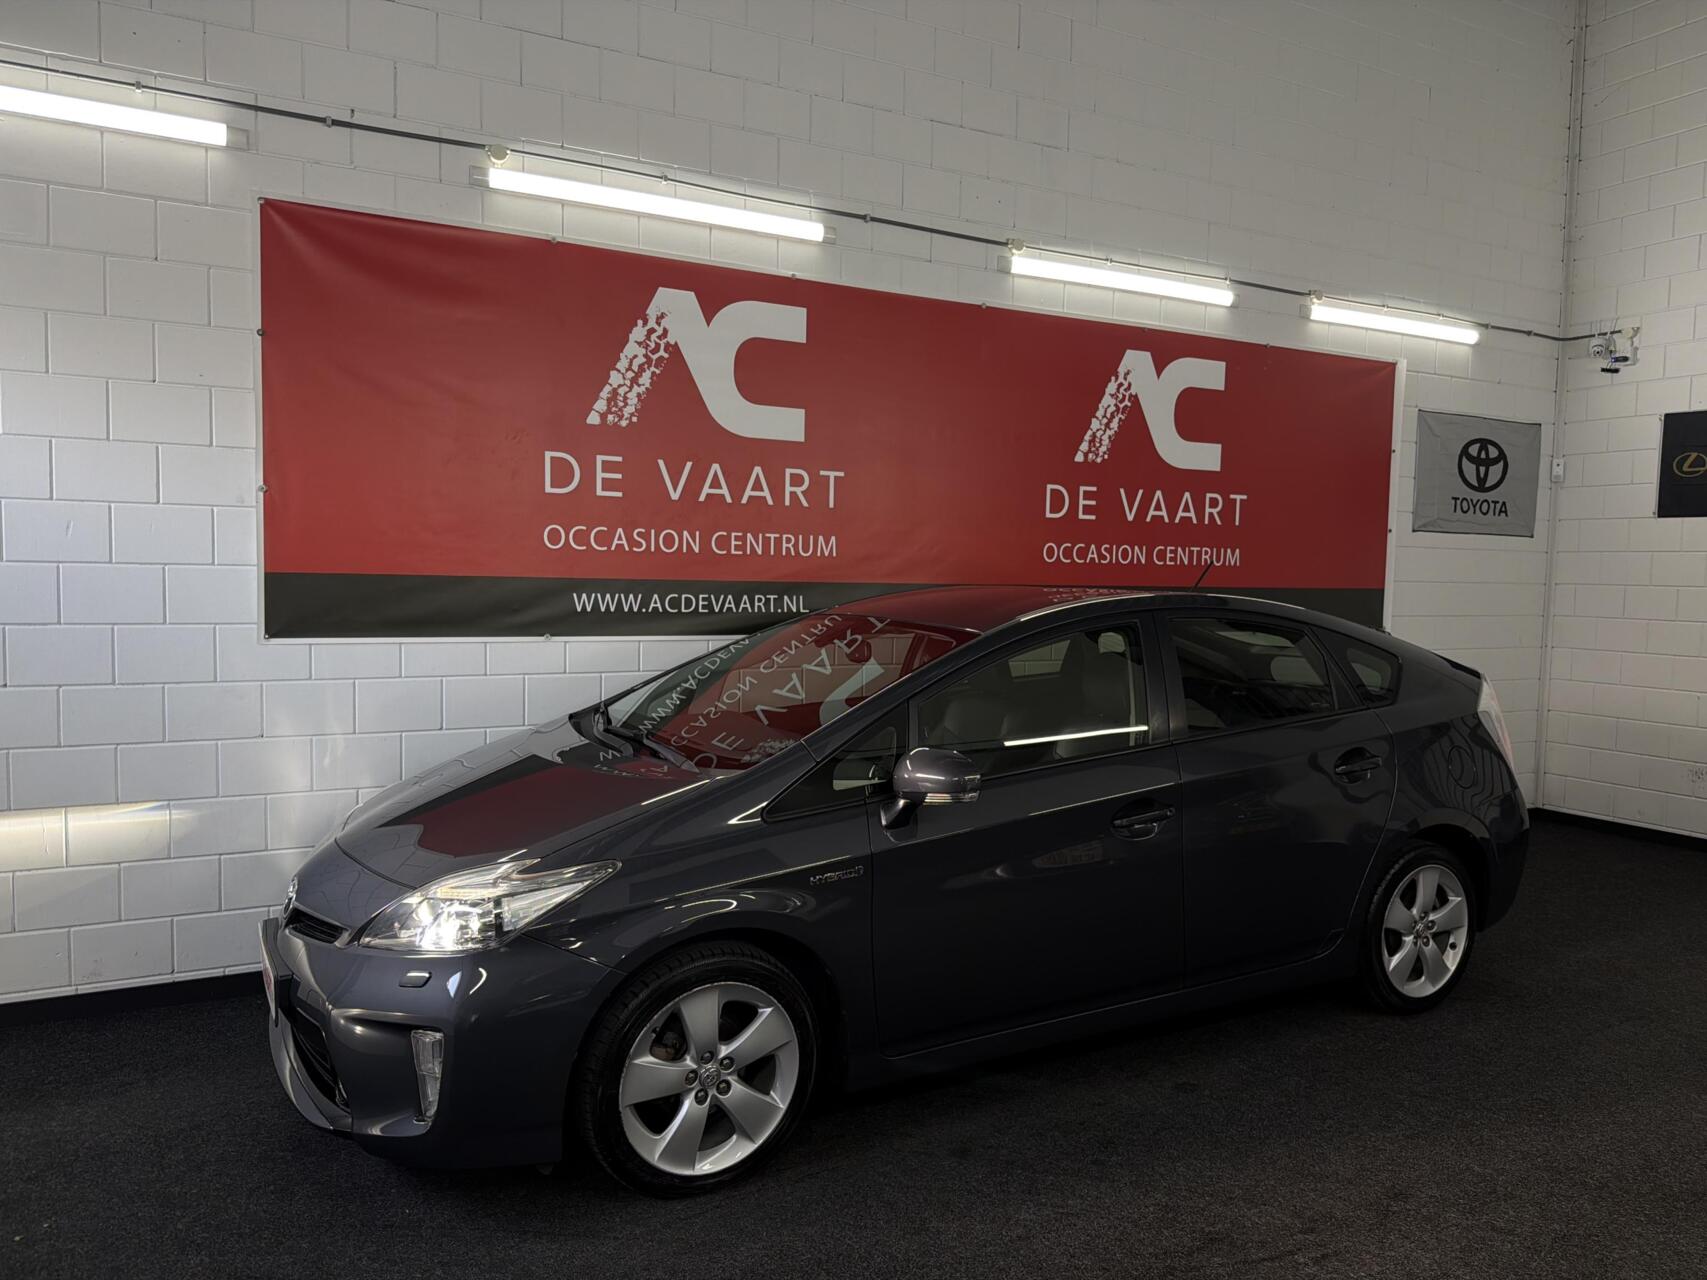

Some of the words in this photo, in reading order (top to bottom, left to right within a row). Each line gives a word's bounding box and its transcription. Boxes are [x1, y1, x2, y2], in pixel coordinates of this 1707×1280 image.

[585, 286, 808, 443] AC
[1073, 348, 1227, 473] AC
[543, 450, 624, 498] DE
[656, 458, 846, 509] VAART
[1044, 483, 1098, 521] DE
[1119, 487, 1248, 526] VAART
[1451, 496, 1509, 518] TOYOTA
[542, 524, 700, 554] OCCASION
[710, 530, 838, 558] CENTRUM
[1042, 542, 1147, 565] OCCASION
[1152, 545, 1241, 567] CENTRUM
[572, 592, 810, 614] WWW.ACDEVAART.NL
